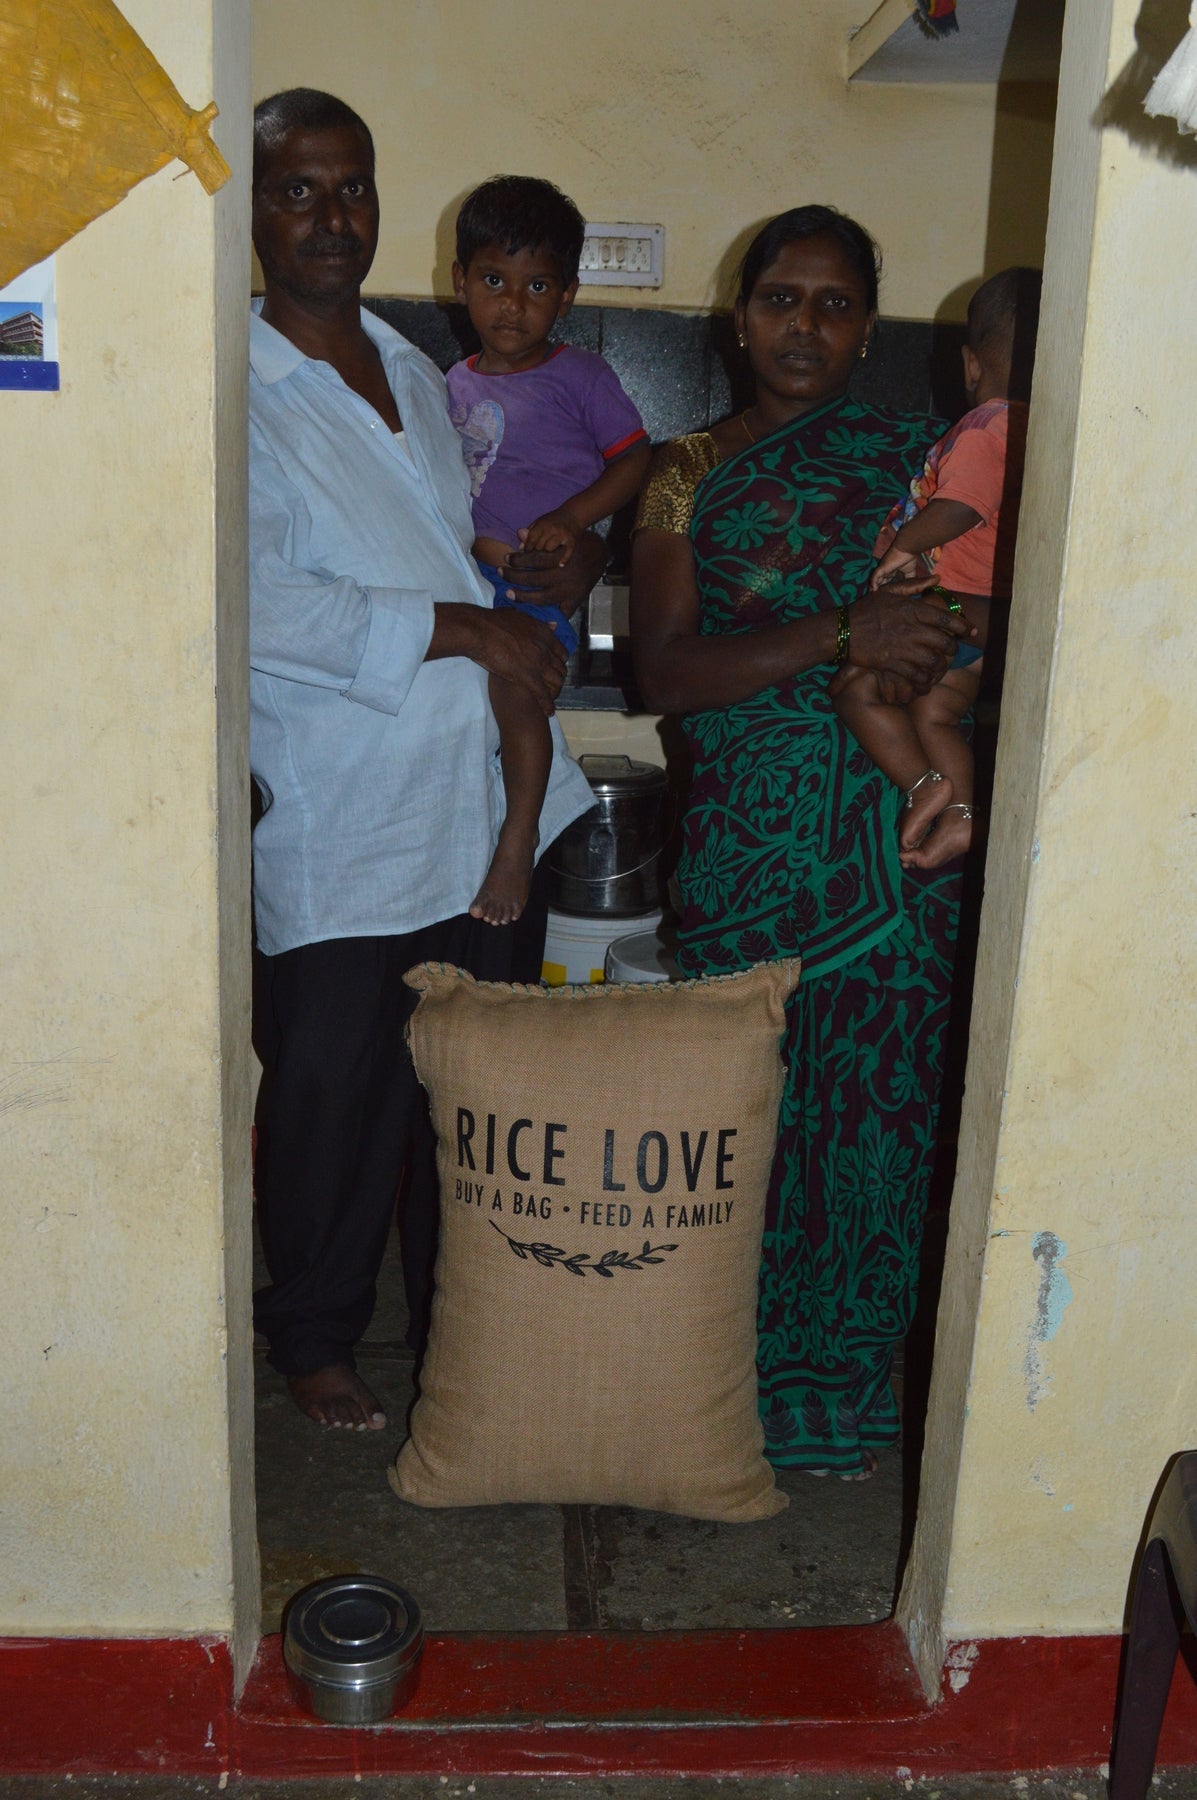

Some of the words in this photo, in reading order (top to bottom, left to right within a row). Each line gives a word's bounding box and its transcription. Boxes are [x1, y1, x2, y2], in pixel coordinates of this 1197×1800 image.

[456, 1106, 568, 1187] RICE
[602, 1128, 738, 1194] LOVE
[455, 1178, 484, 1207] BUY
[491, 1188, 503, 1212] A
[512, 1192, 552, 1220] BAG
[580, 1201, 632, 1228] FEED
[642, 1205, 655, 1229] A
[666, 1200, 734, 1229] FAMILY
